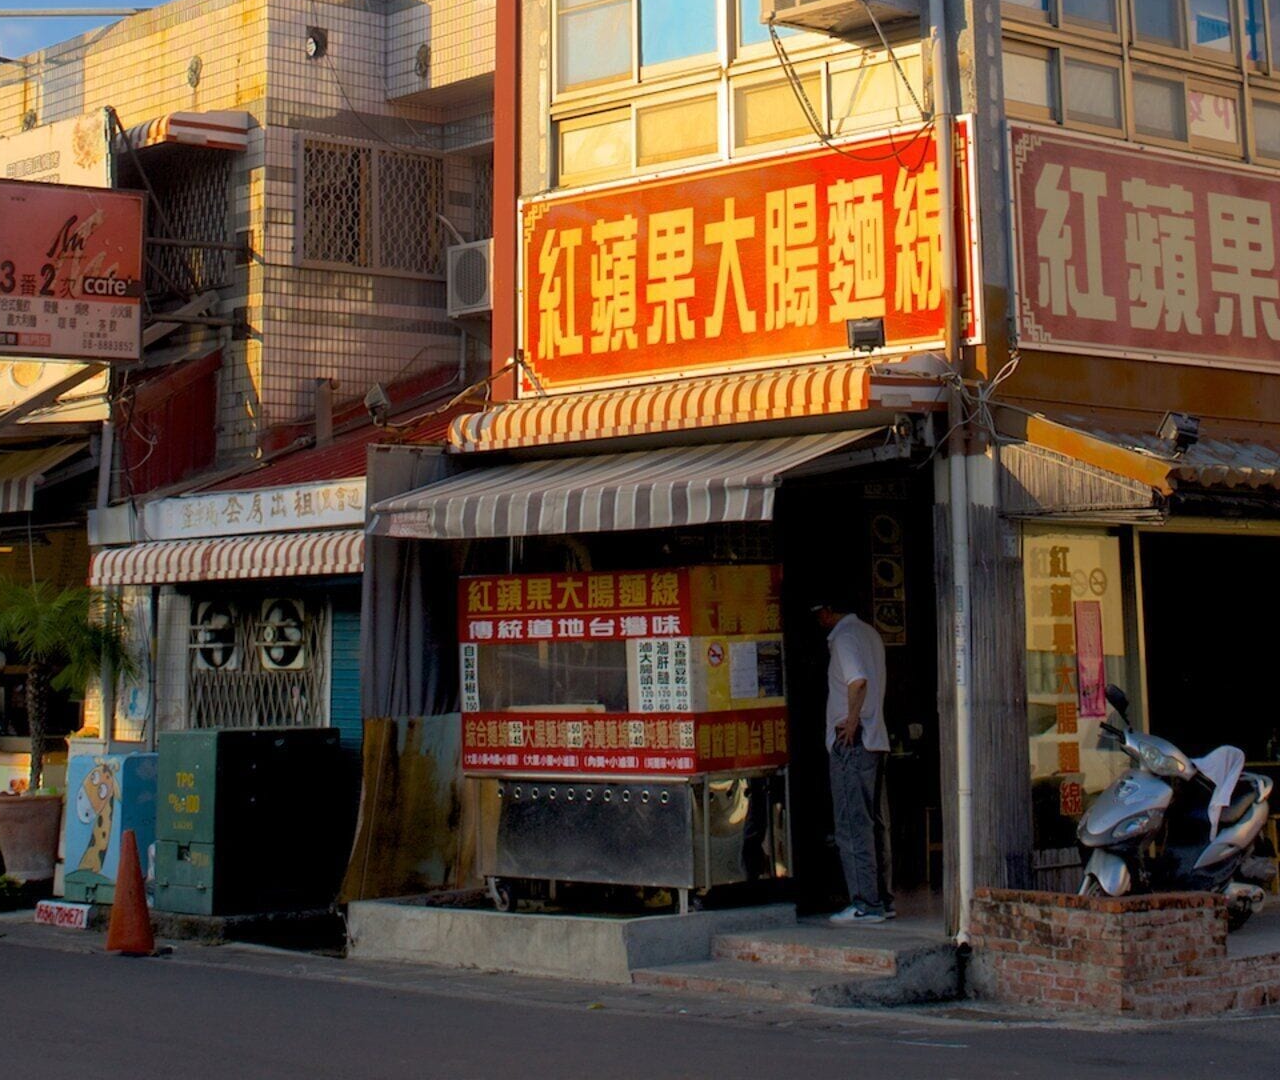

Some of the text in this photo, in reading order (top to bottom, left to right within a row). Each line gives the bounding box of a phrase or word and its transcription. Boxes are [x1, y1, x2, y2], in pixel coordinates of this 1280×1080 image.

[536, 166, 943, 361] 紅蘋果大腸麵線
[467, 572, 680, 612] 紅蘋果大腸麵線
[468, 614, 682, 640] 傳統道地台灣味
[1048, 545, 1083, 816] 紅蘋果大腸麵線
